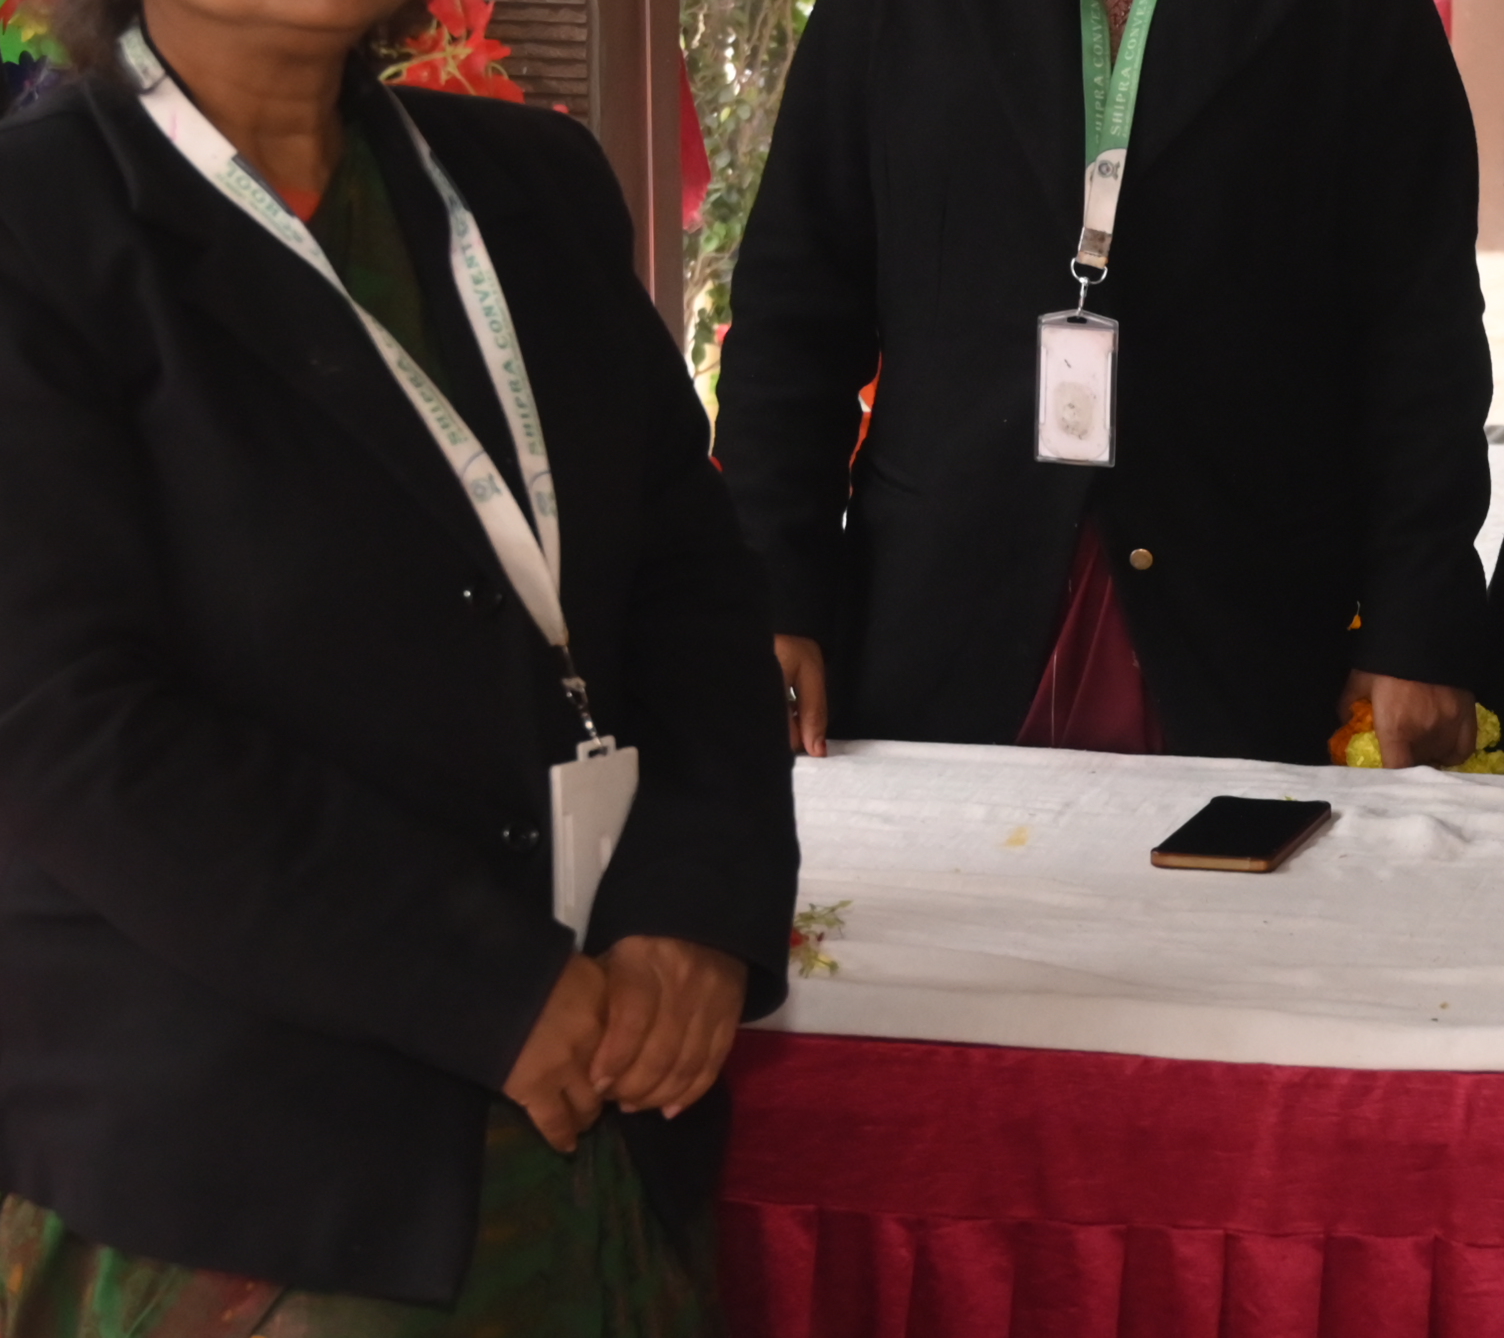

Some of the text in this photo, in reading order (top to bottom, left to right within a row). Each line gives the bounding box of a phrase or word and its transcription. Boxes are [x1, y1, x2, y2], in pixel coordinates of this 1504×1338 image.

[1093, 76, 1105, 144] HIPRA
[1110, 67, 1132, 137] SHIPRA
[461, 243, 544, 456] SHIPRA CONVENT
